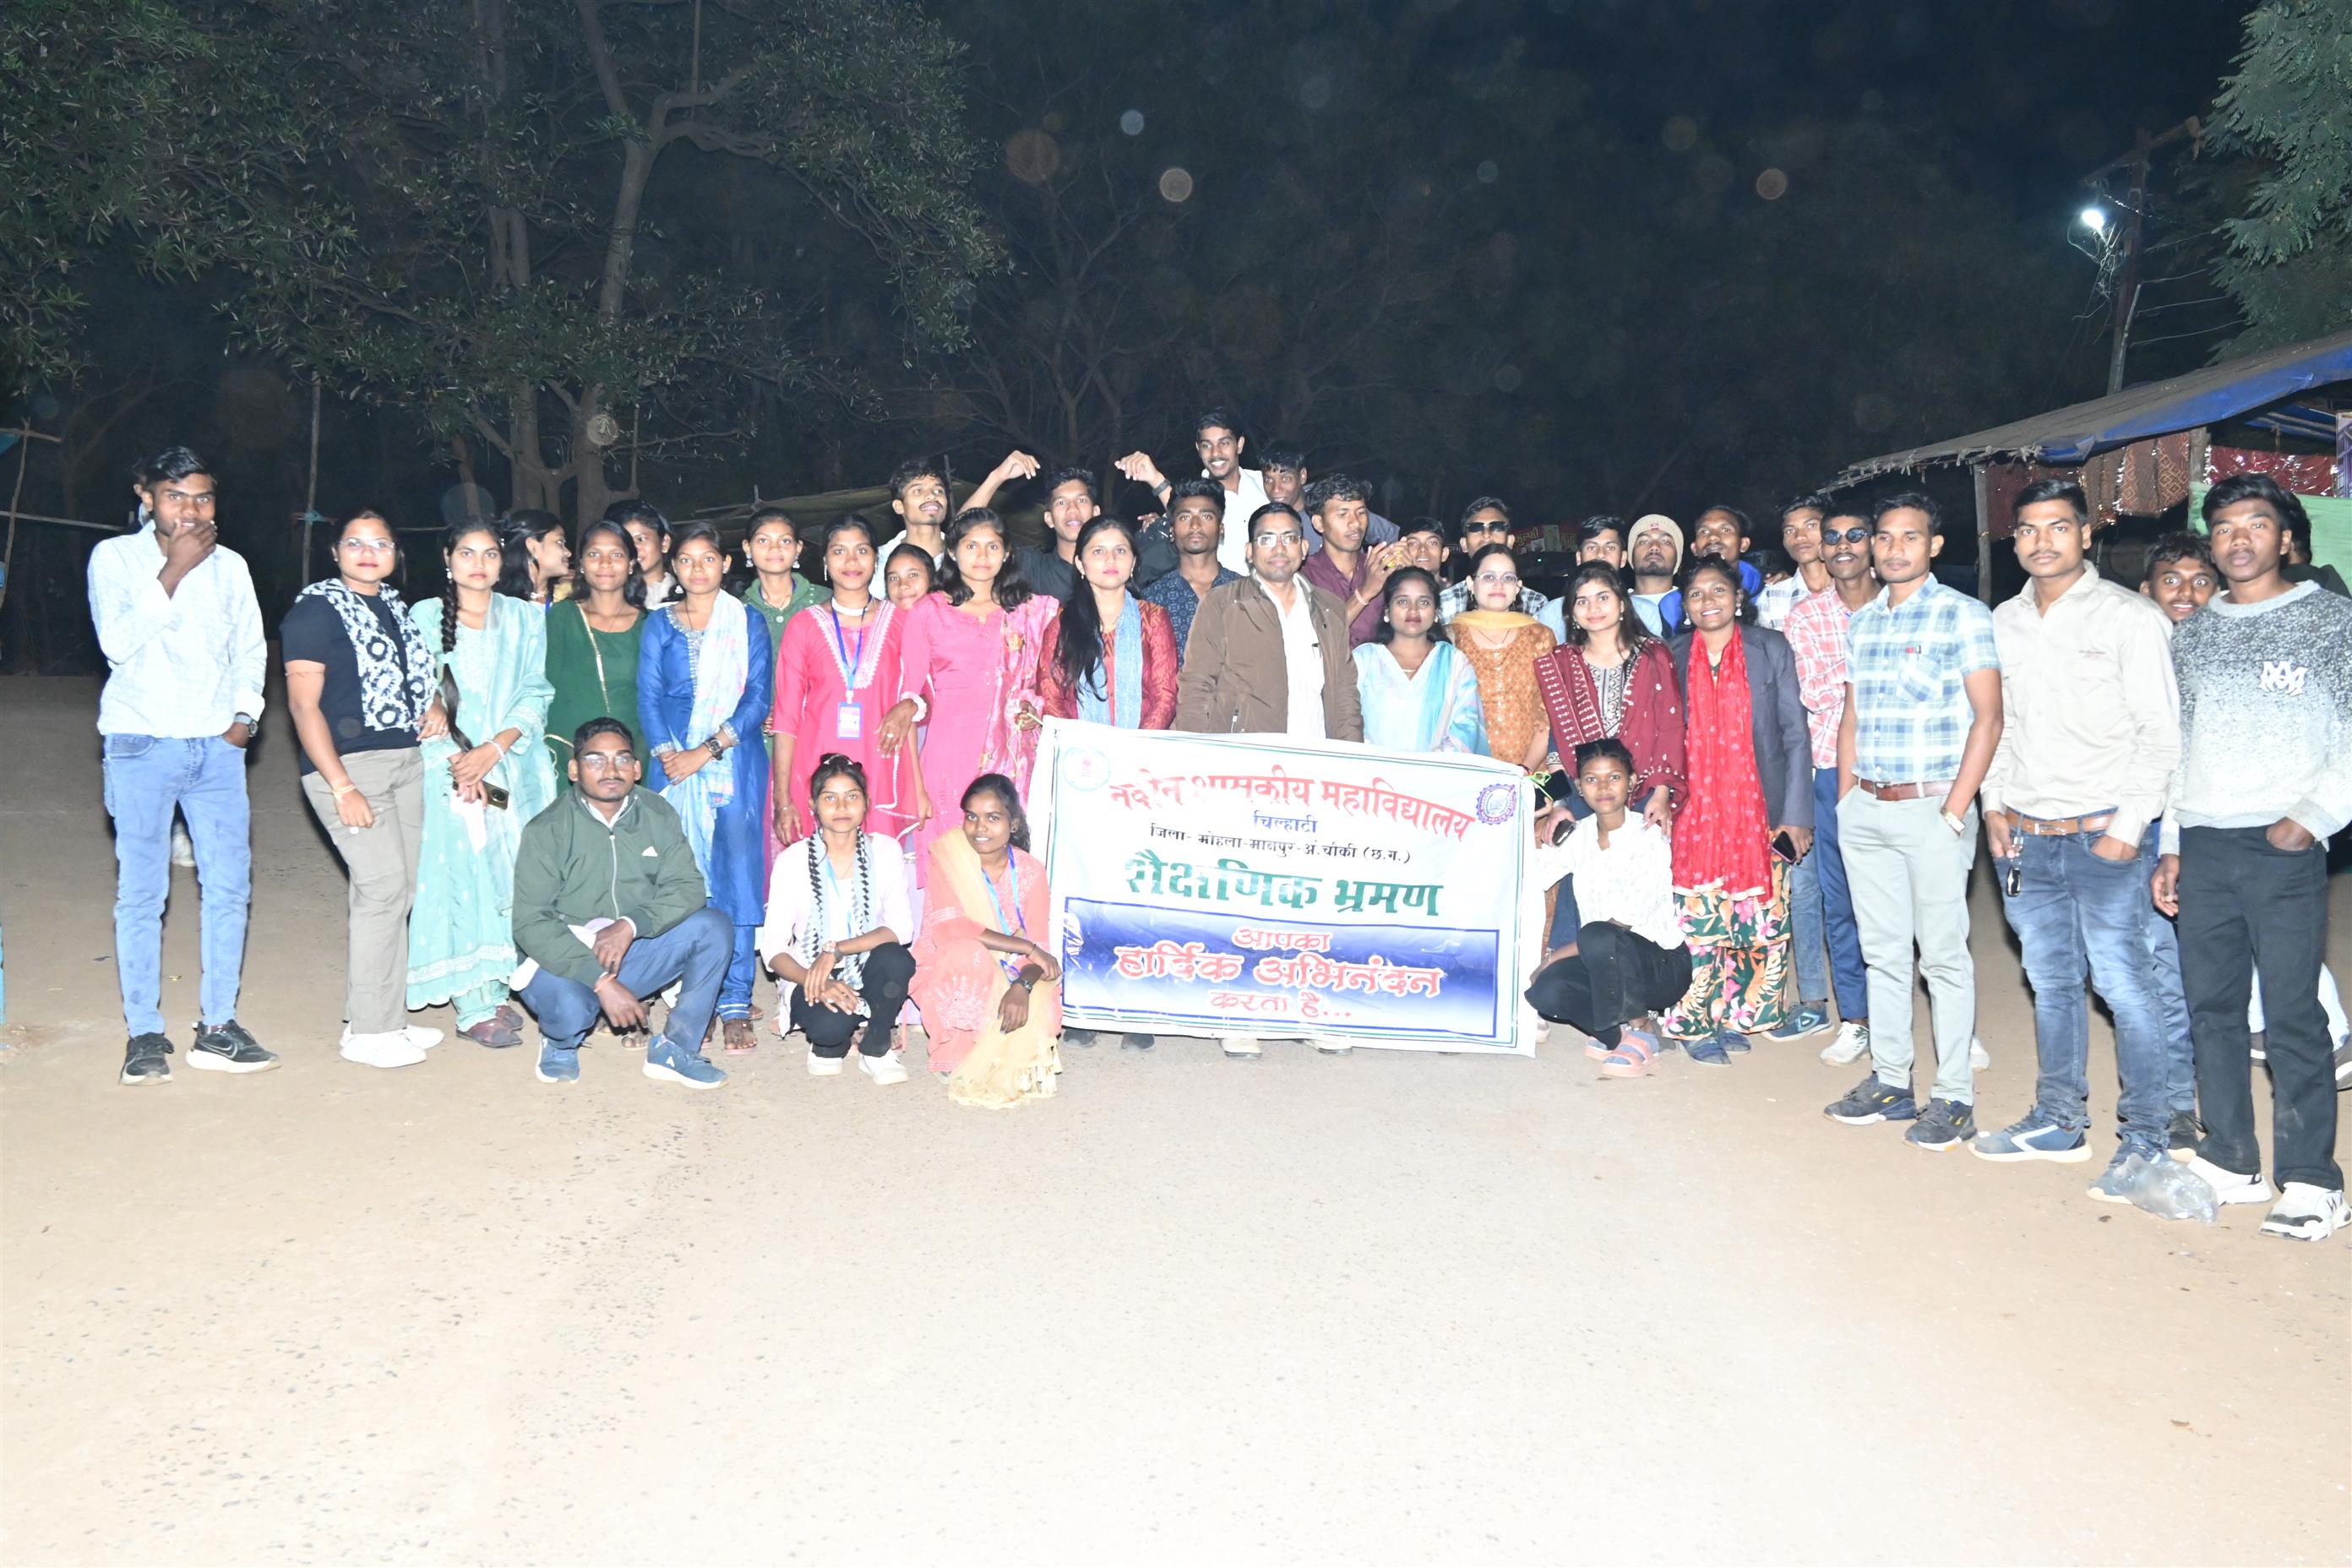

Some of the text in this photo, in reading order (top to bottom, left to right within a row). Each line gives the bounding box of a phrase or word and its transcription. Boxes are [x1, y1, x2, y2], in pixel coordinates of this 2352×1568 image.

[1253, 809, 1318, 834] चिल्हाटी
[1320, 776, 1477, 842] महाविद्यालय
[1124, 848, 1445, 917] शैक्षणिक भ्रमण
[1234, 928, 1332, 952] आपका
[1116, 943, 1441, 999] हार्दिक अभिनंदन
[1210, 991, 1289, 1013] करता
